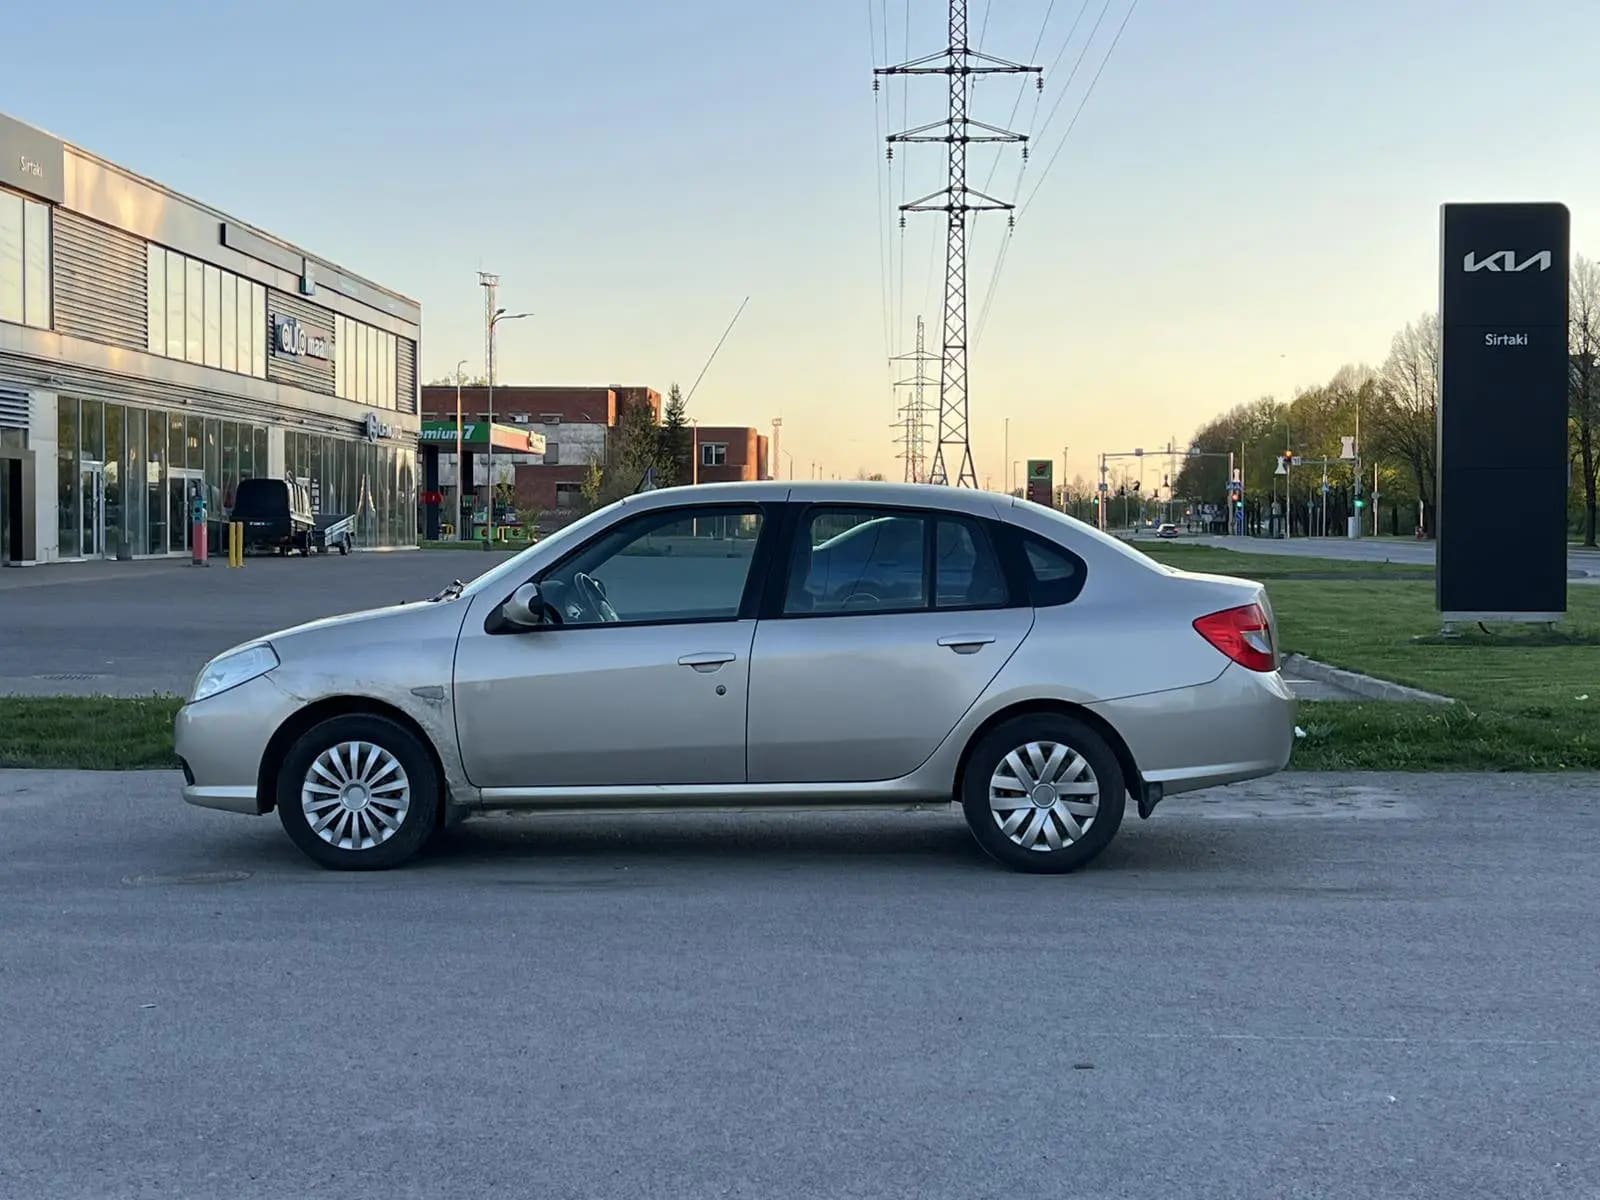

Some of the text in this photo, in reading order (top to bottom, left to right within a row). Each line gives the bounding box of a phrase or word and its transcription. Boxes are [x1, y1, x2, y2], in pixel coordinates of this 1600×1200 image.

[1463, 250, 1552, 272] KIA
[1485, 333, 1528, 346] Sirtaki
[463, 424, 475, 440] 7
